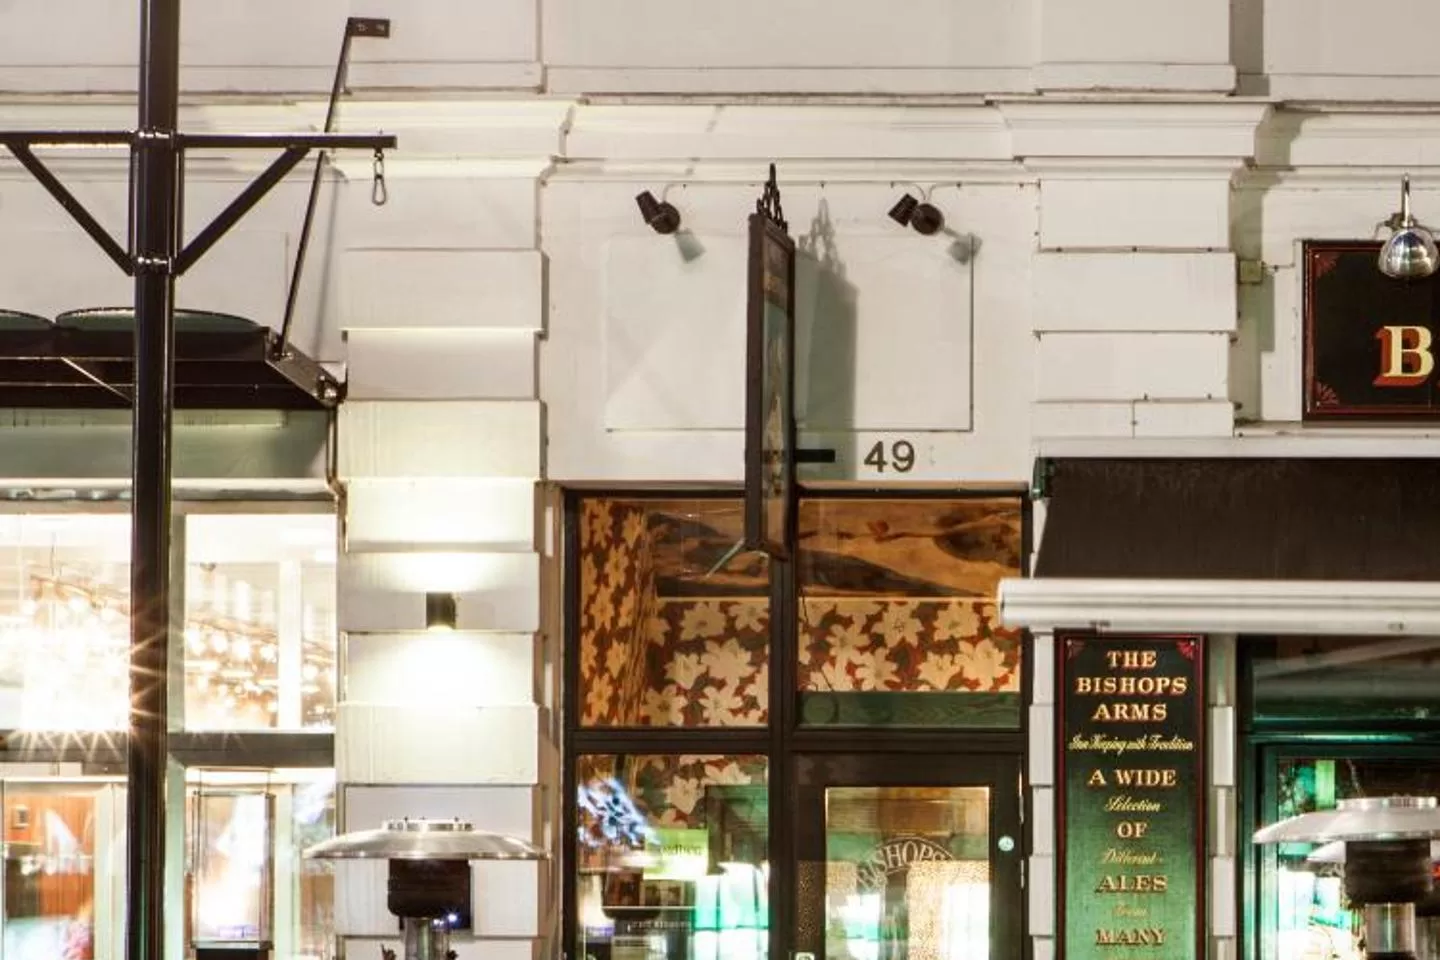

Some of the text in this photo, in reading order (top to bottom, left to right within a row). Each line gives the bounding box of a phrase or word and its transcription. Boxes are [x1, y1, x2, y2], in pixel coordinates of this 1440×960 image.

[863, 440, 915, 473] 49
[1106, 650, 1157, 669] THE
[1076, 677, 1187, 695] BISHOPS
[1092, 703, 1167, 721] ARMS
[1086, 769, 1177, 787] A WIDE
[1104, 794, 1161, 812] Selection
[1116, 822, 1148, 839] OF
[1096, 875, 1168, 893] ALES
[1096, 927, 1168, 946] MANY
